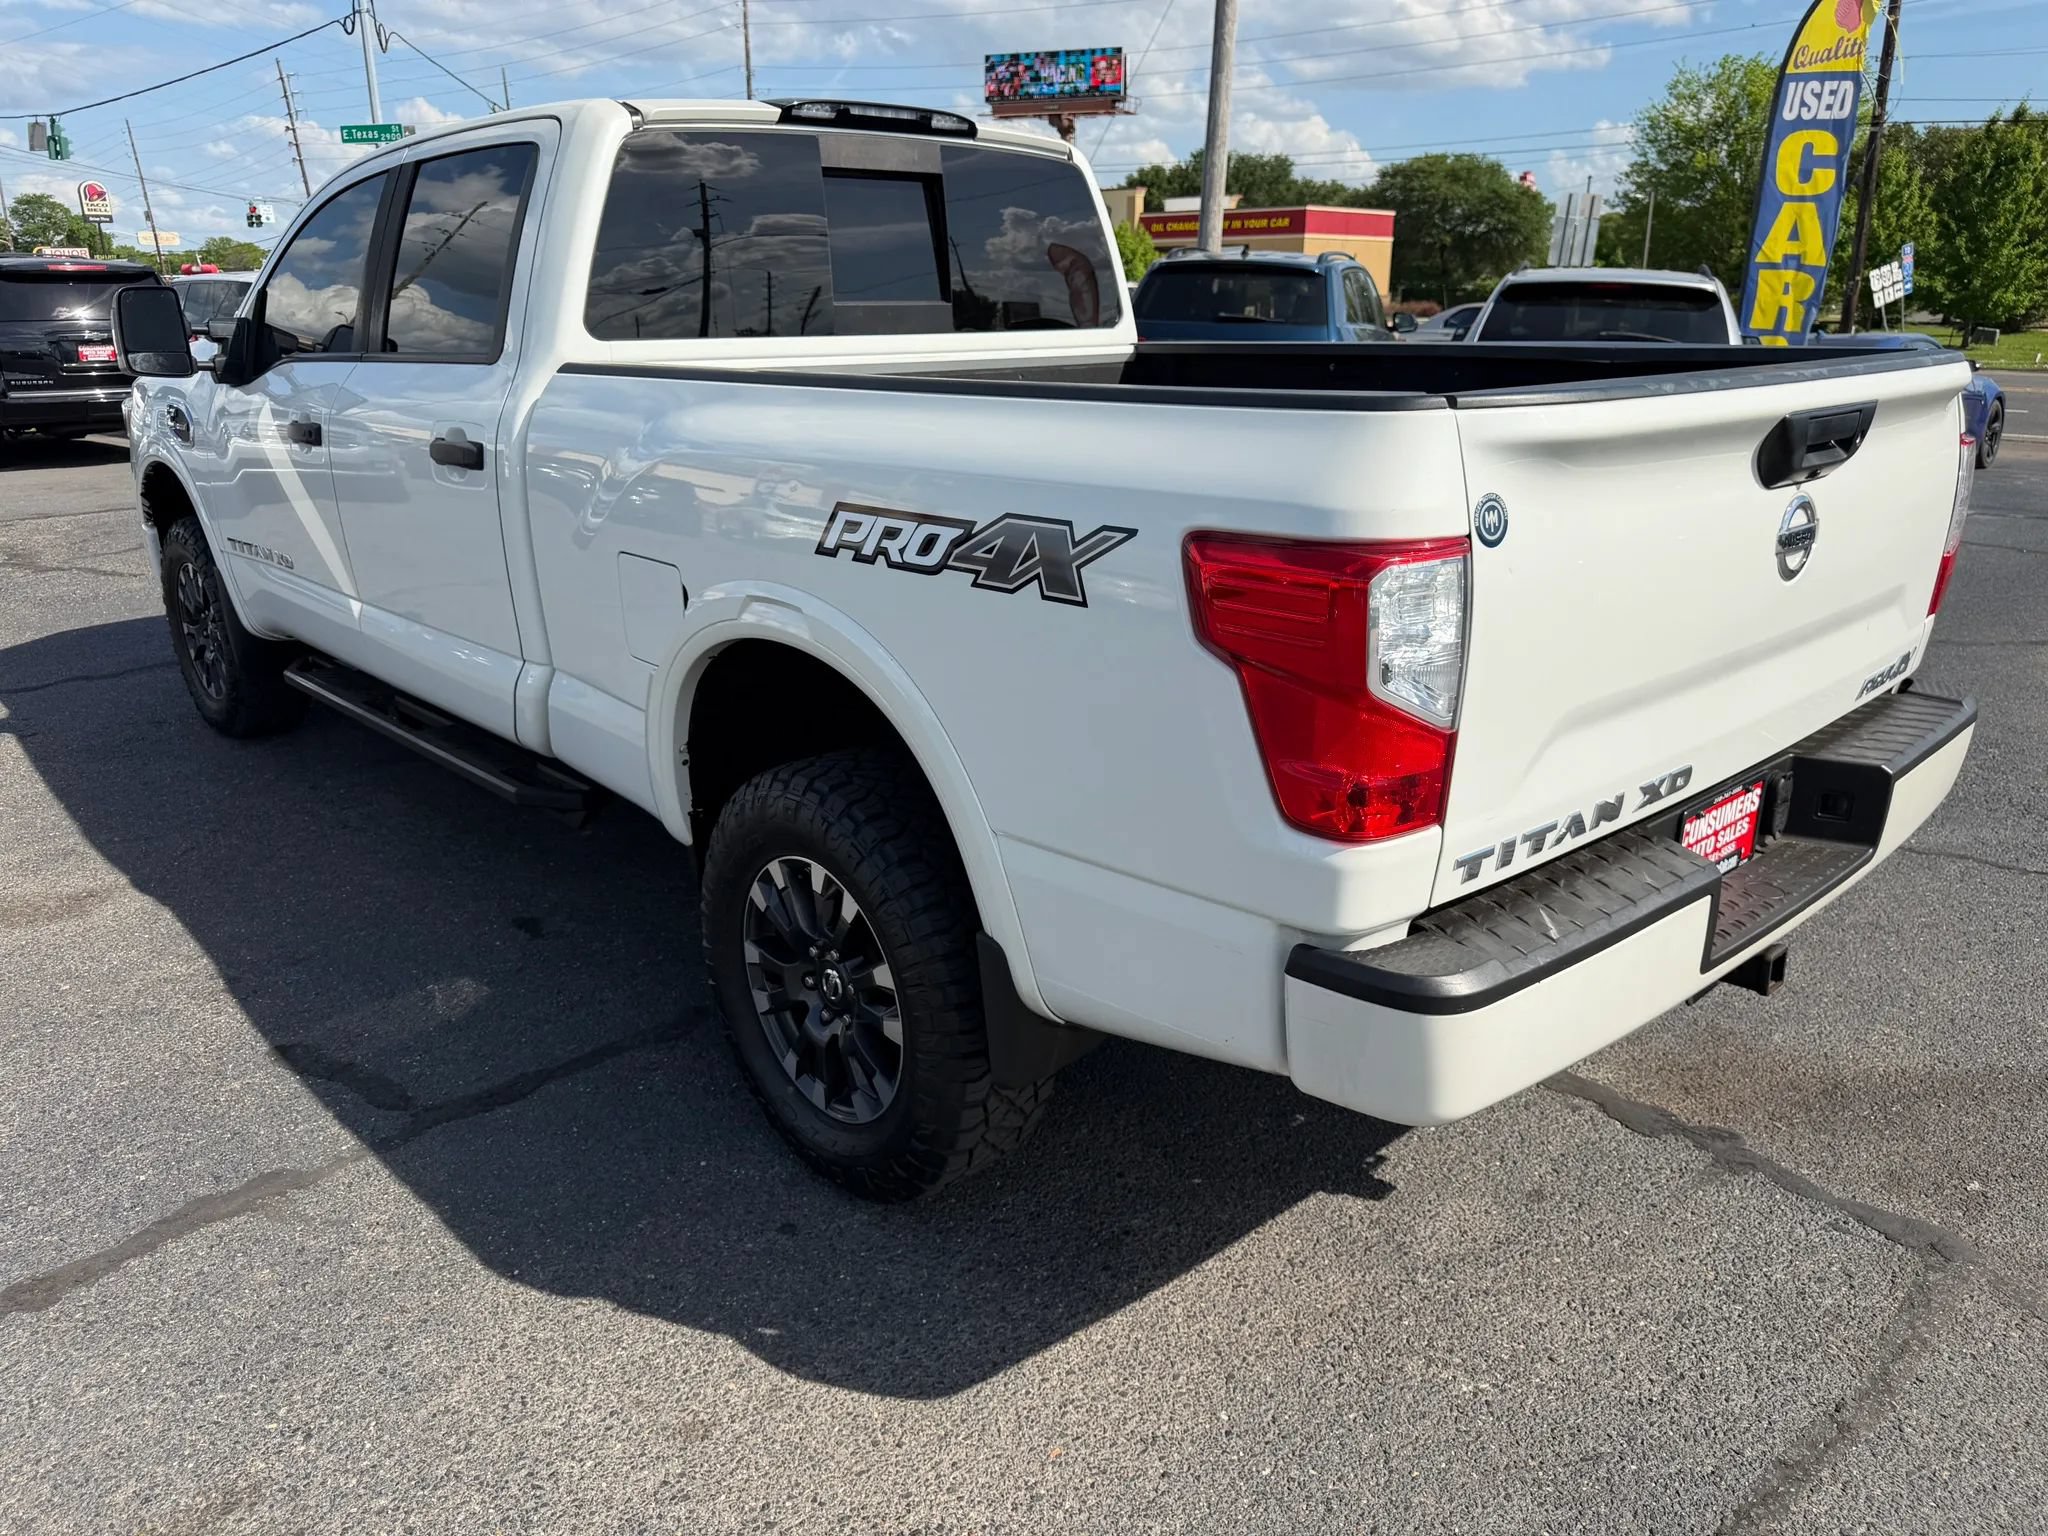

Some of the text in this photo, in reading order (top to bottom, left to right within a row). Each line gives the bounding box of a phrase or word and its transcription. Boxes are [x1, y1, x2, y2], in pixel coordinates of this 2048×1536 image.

[1782, 80, 1854, 121] USED
[380, 133, 402, 141] 2900
[1151, 223, 1165, 233] OIL
[1231, 220, 1242, 229] IN
[1243, 218, 1269, 229] YOUR
[1269, 217, 1290, 228] CAR
[1750, 129, 1838, 346] CAR
[227, 536, 275, 563] TITAN
[1452, 764, 1693, 885] TITAN XD
[1681, 787, 1762, 847] CONSUMERS
[1716, 816, 1751, 849] SALES
